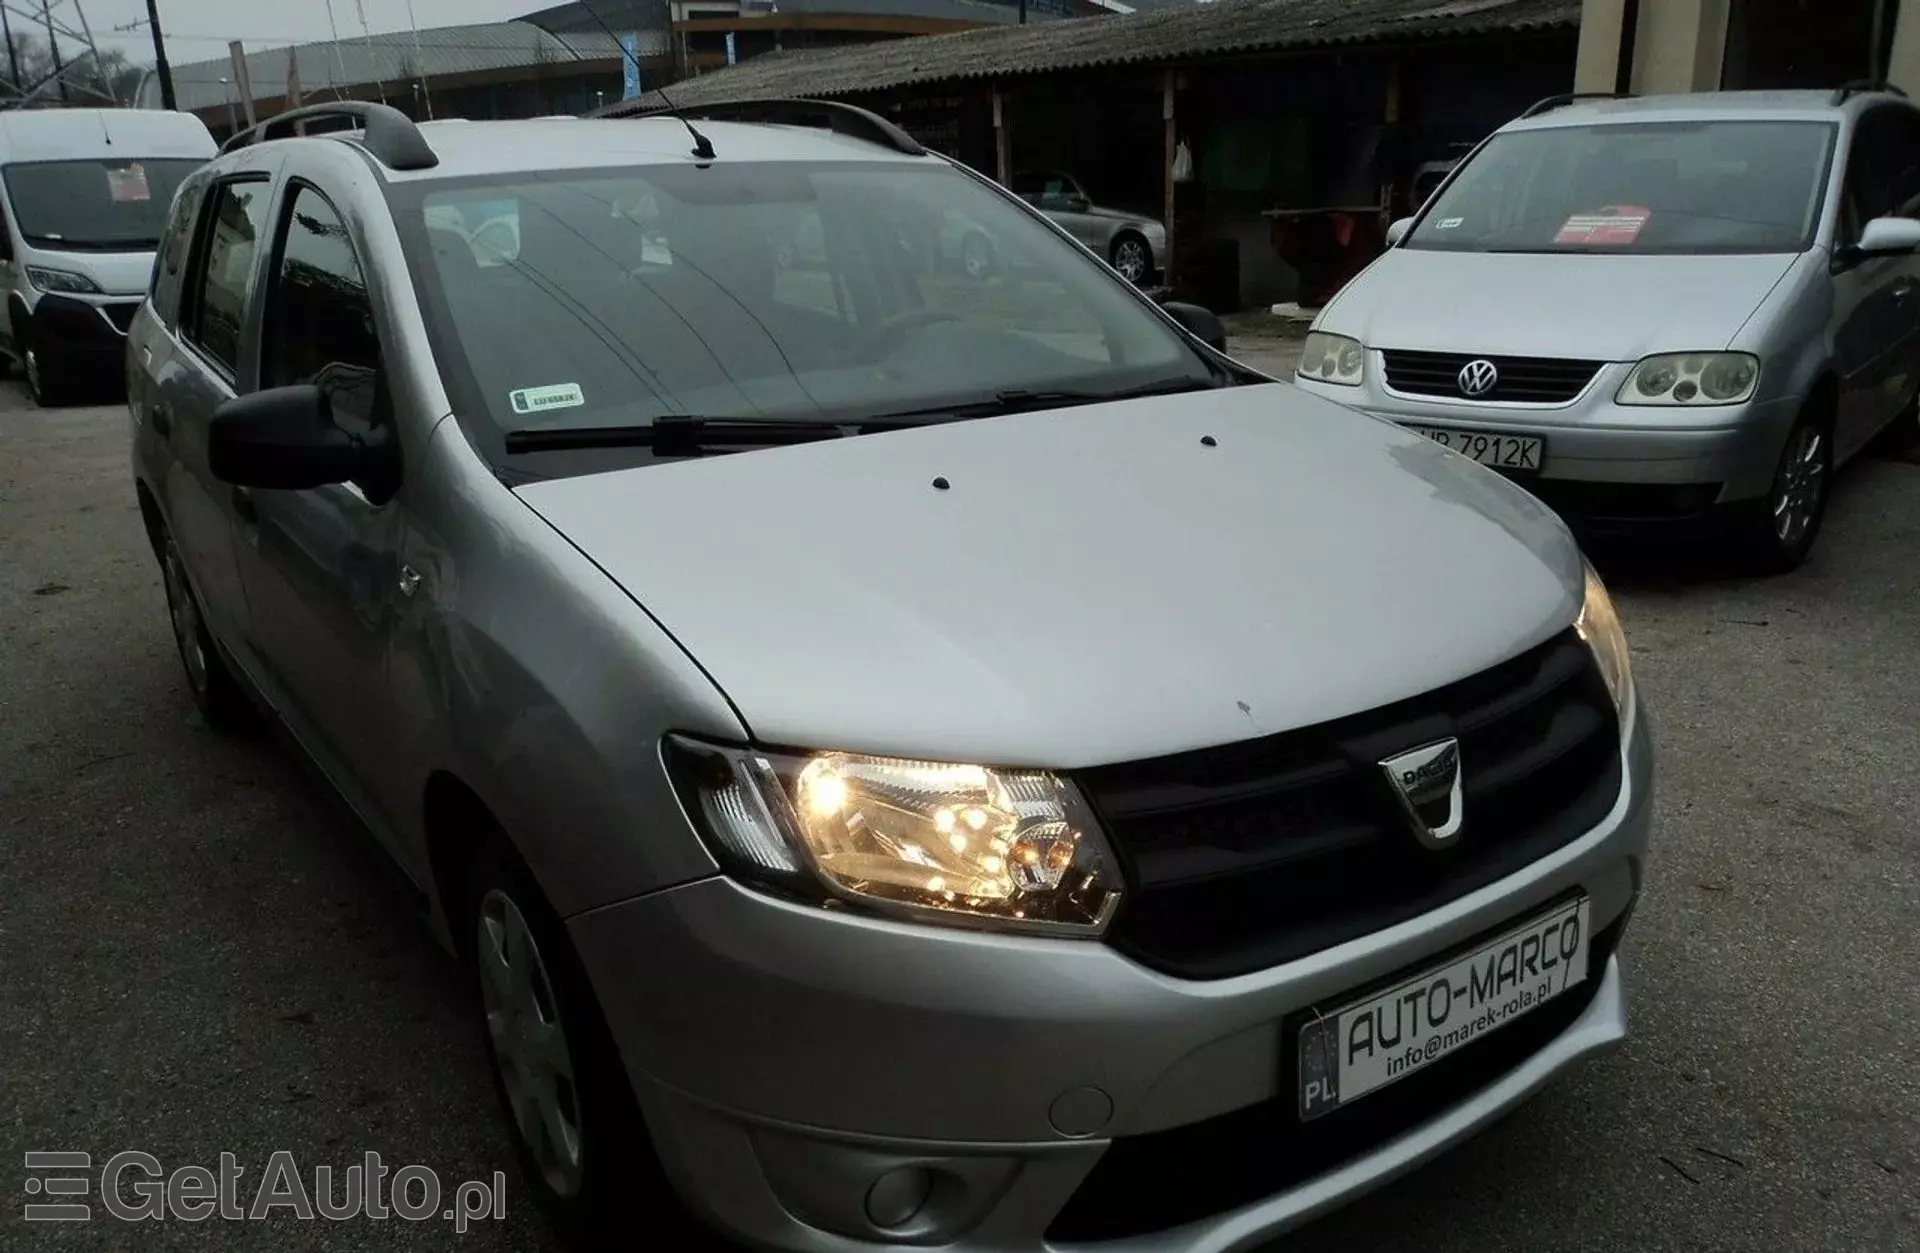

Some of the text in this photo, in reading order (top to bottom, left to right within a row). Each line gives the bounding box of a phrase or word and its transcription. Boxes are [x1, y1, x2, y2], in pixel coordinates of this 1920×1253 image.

[1459, 434, 1538, 468] 7912K
[1348, 914, 1580, 1066] AUTO-MARCO
[1387, 976, 1552, 1077] info@marek-rola.pl
[1305, 1076, 1336, 1110] PL
